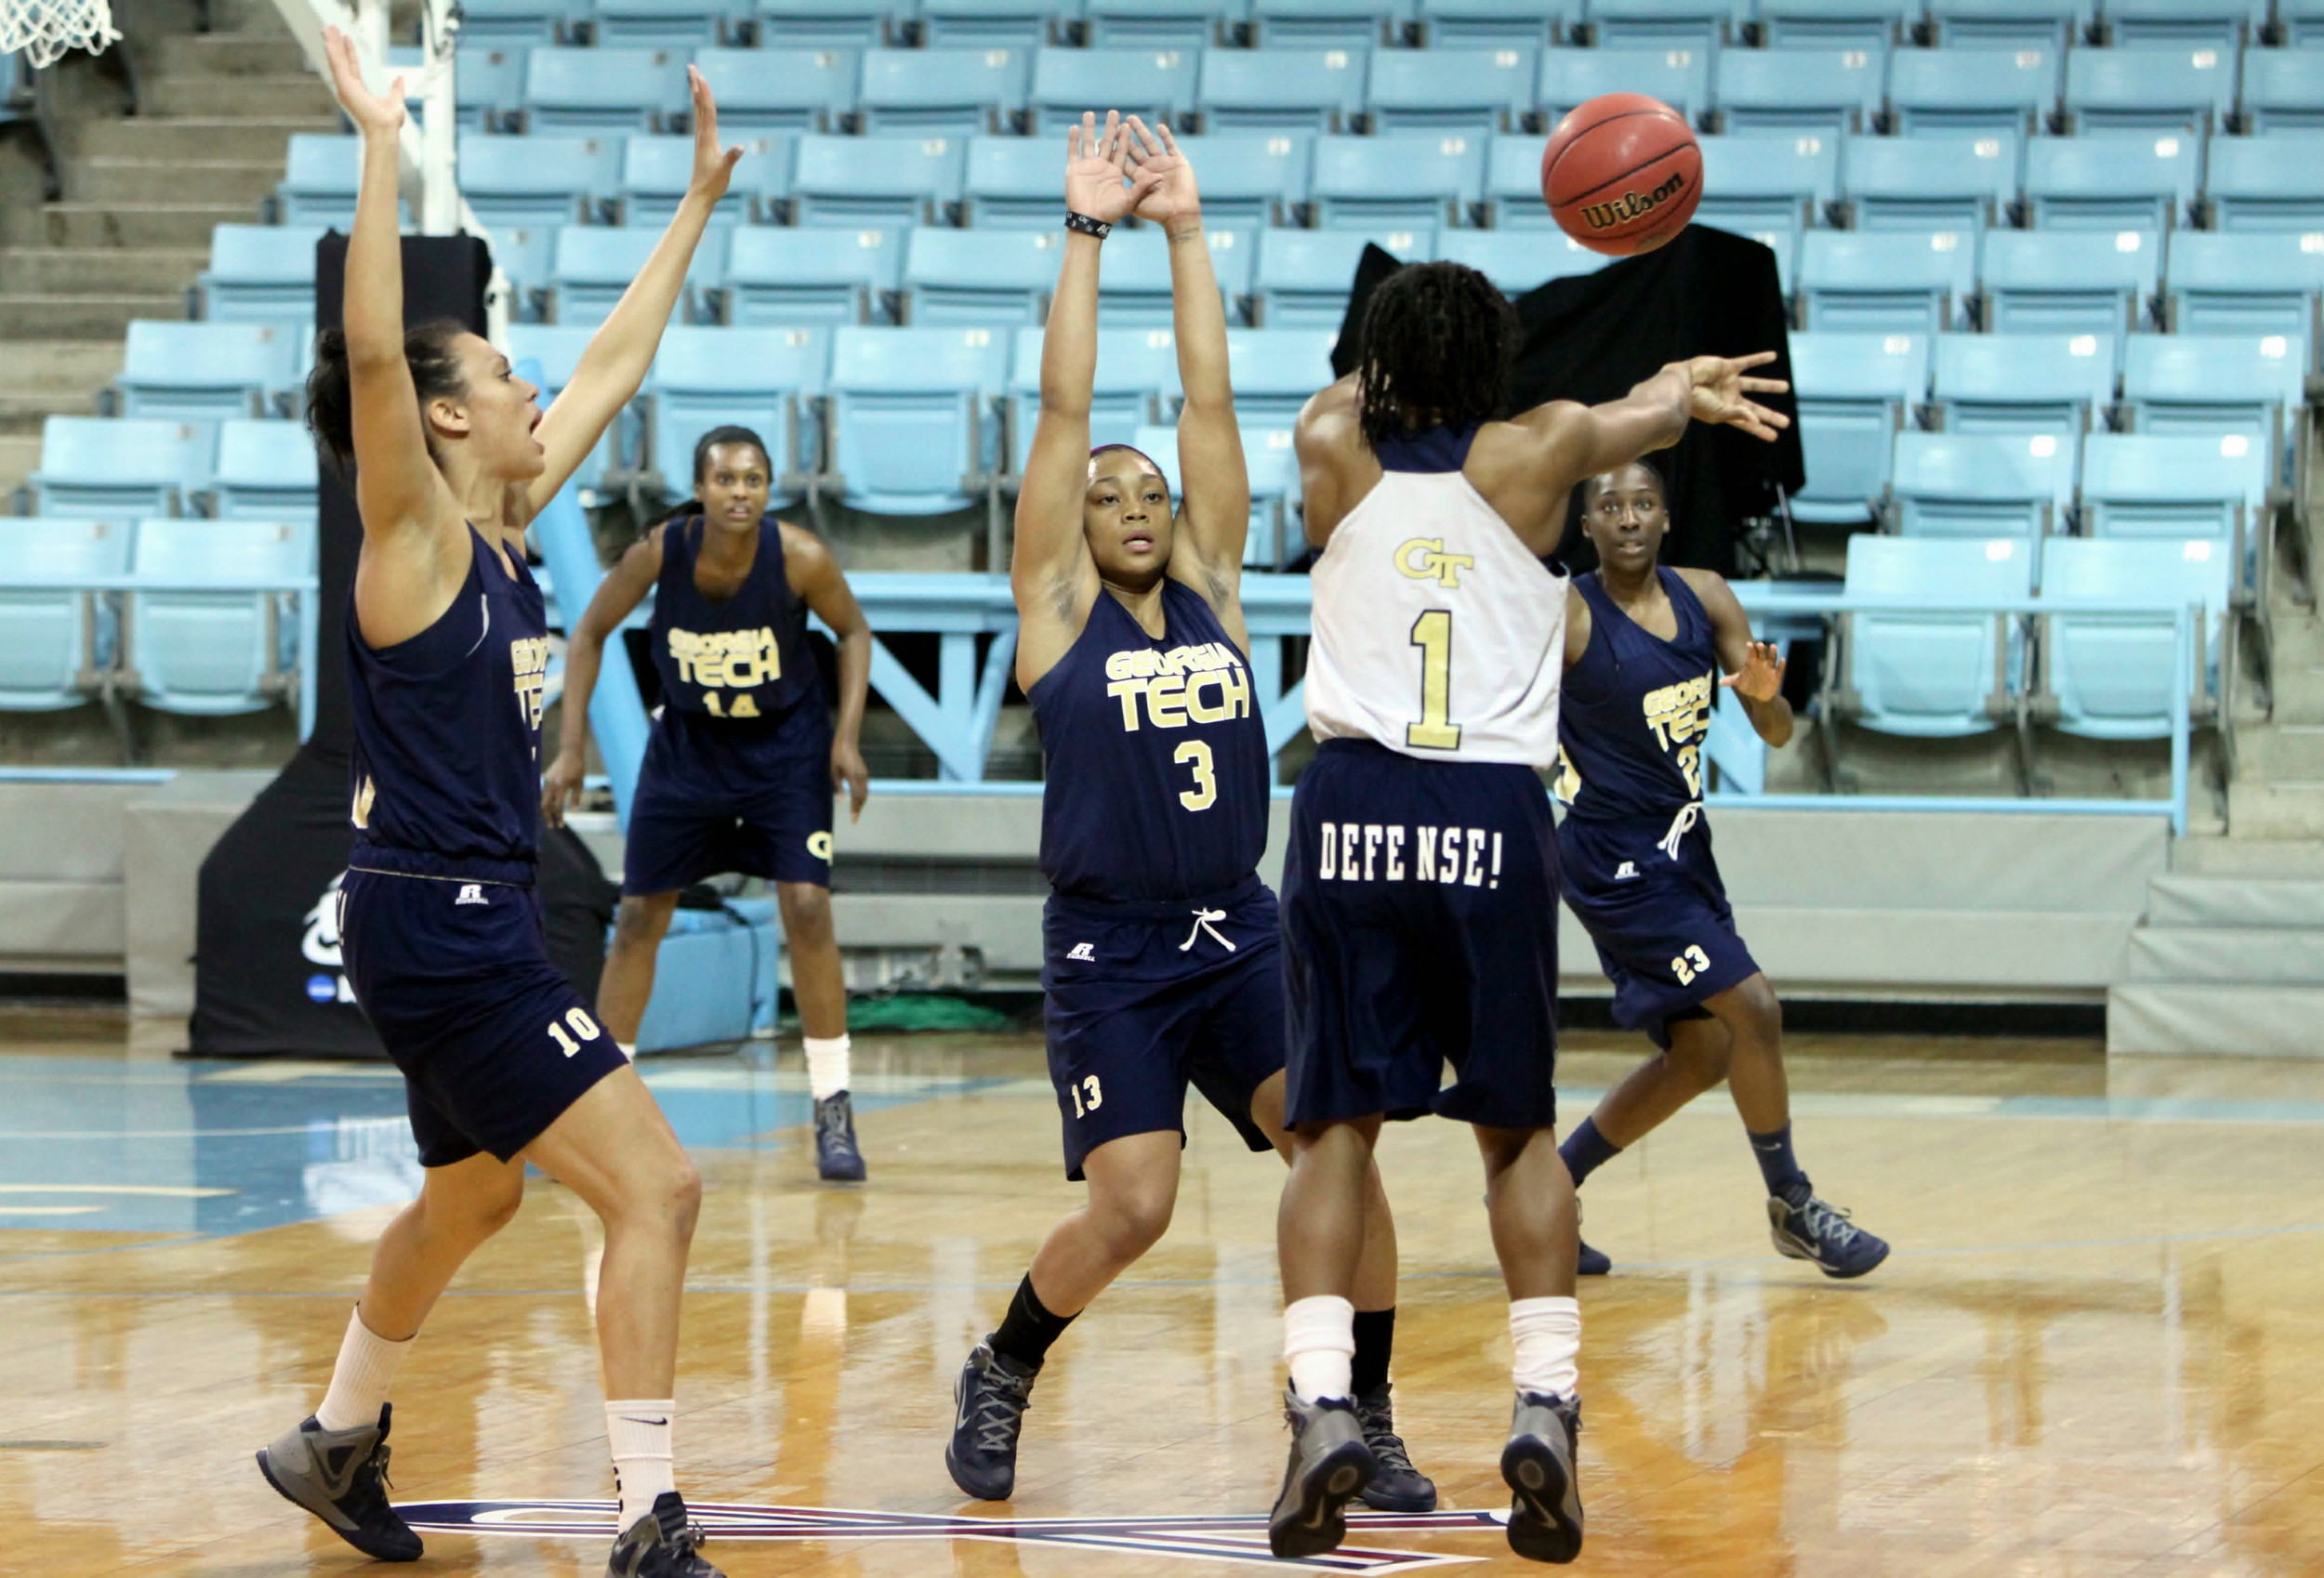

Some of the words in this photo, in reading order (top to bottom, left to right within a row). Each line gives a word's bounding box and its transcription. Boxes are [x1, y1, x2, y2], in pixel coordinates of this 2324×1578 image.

[1581, 173, 1684, 230] Wilson
[1393, 537, 1474, 588] GT
[668, 625, 778, 654] GEORGIA
[1105, 642, 1242, 680] GEORGIA
[669, 648, 781, 688] TECH
[1406, 609, 1462, 750] 1
[703, 690, 760, 717] 14
[1107, 668, 1249, 732] TECH
[1174, 740, 1217, 812] 3
[1671, 944, 1710, 986] 23
[548, 1006, 601, 1058] 10
[1071, 1074, 1103, 1119] 13
